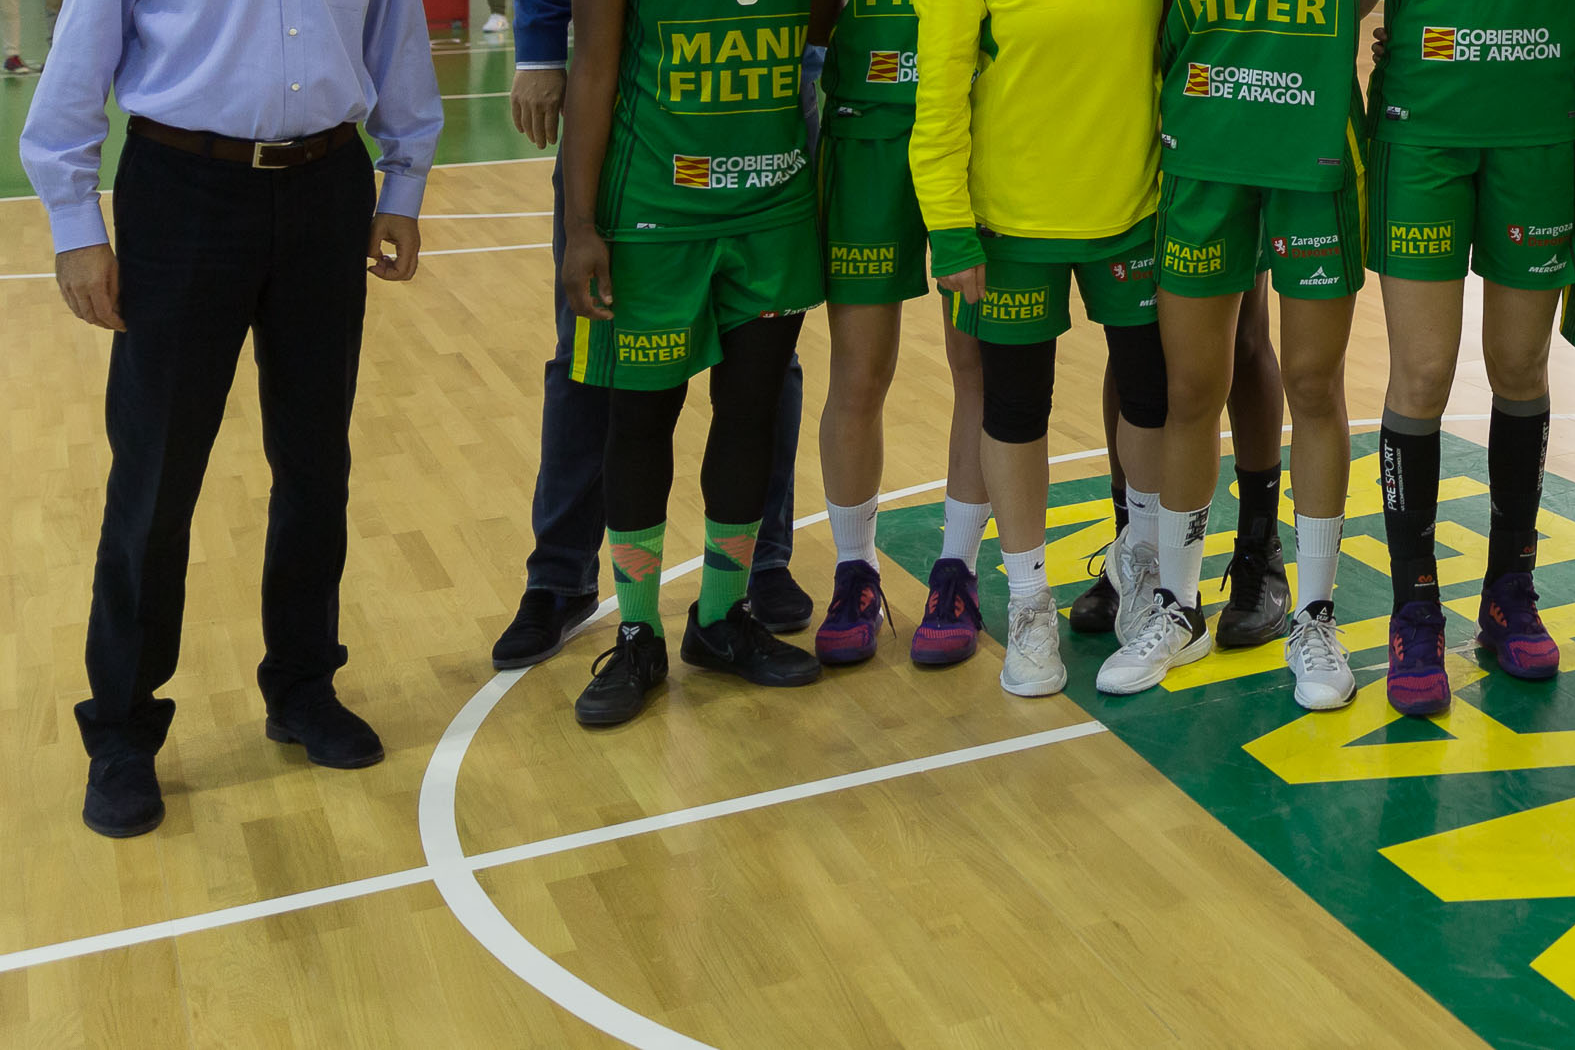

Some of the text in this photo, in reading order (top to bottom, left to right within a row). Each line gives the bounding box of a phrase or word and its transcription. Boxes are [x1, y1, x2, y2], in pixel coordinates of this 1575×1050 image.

[1457, 27, 1549, 46] GOBIERNO
[1457, 44, 1561, 61] DE ARAGON
[670, 65, 801, 102] FILTE
[1211, 66, 1303, 88] GOBIERNO
[1211, 82, 1315, 105] DE ARAGON
[712, 173, 738, 188] DE
[1391, 225, 1451, 239] MANN
[1528, 222, 1573, 237] Zaragoza
[1291, 234, 1338, 248] Zaragoza
[1391, 240, 1451, 254] FILTER
[831, 246, 894, 261] MANN
[1167, 241, 1221, 259] MANN
[831, 261, 894, 275] FILTER
[1165, 258, 1221, 274] FILTER
[1528, 261, 1567, 273] MERCURY
[1300, 276, 1340, 285] MERCURY
[983, 290, 1045, 305] MANN
[982, 305, 1045, 319] FILTER
[619, 332, 686, 348] MANN
[619, 347, 686, 362] FILTER
[1384, 442, 1397, 511] PRESPORT
